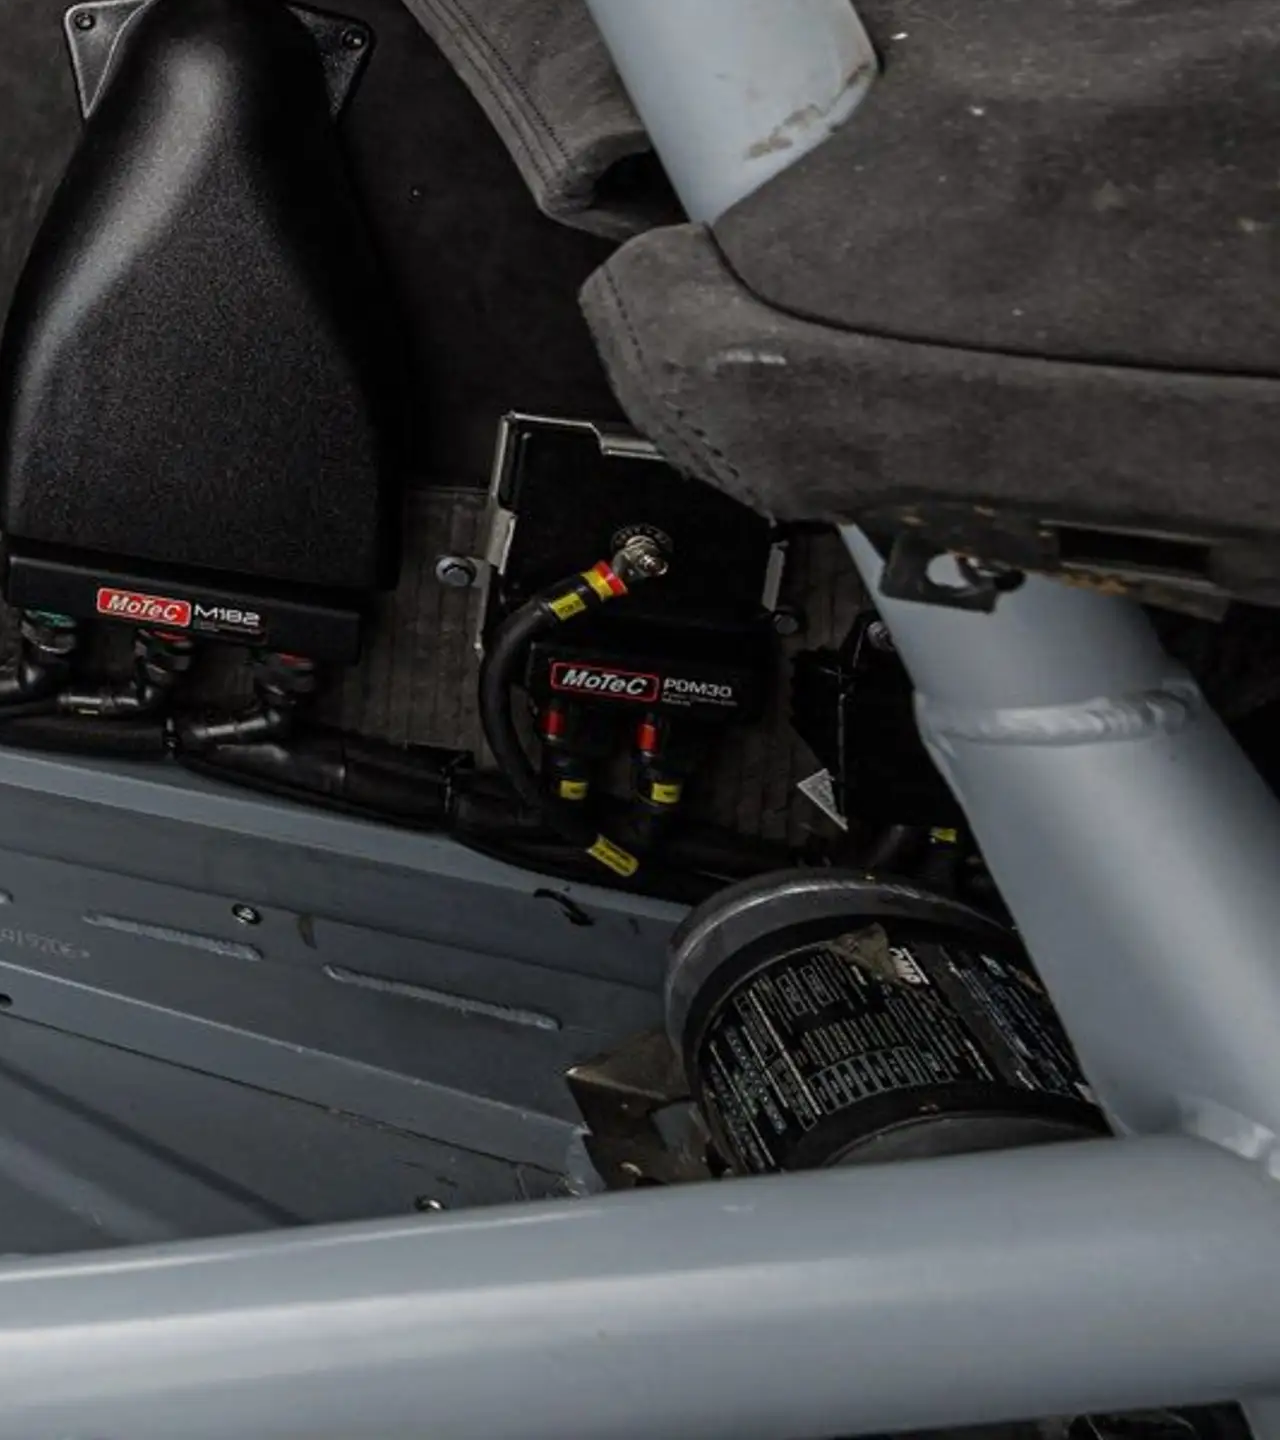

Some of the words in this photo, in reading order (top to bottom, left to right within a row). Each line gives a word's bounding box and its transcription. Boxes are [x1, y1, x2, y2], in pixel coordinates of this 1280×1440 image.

[106, 594, 181, 622] MoTeC
[562, 669, 648, 695] MoTeC
[663, 677, 732, 698] PDM30
